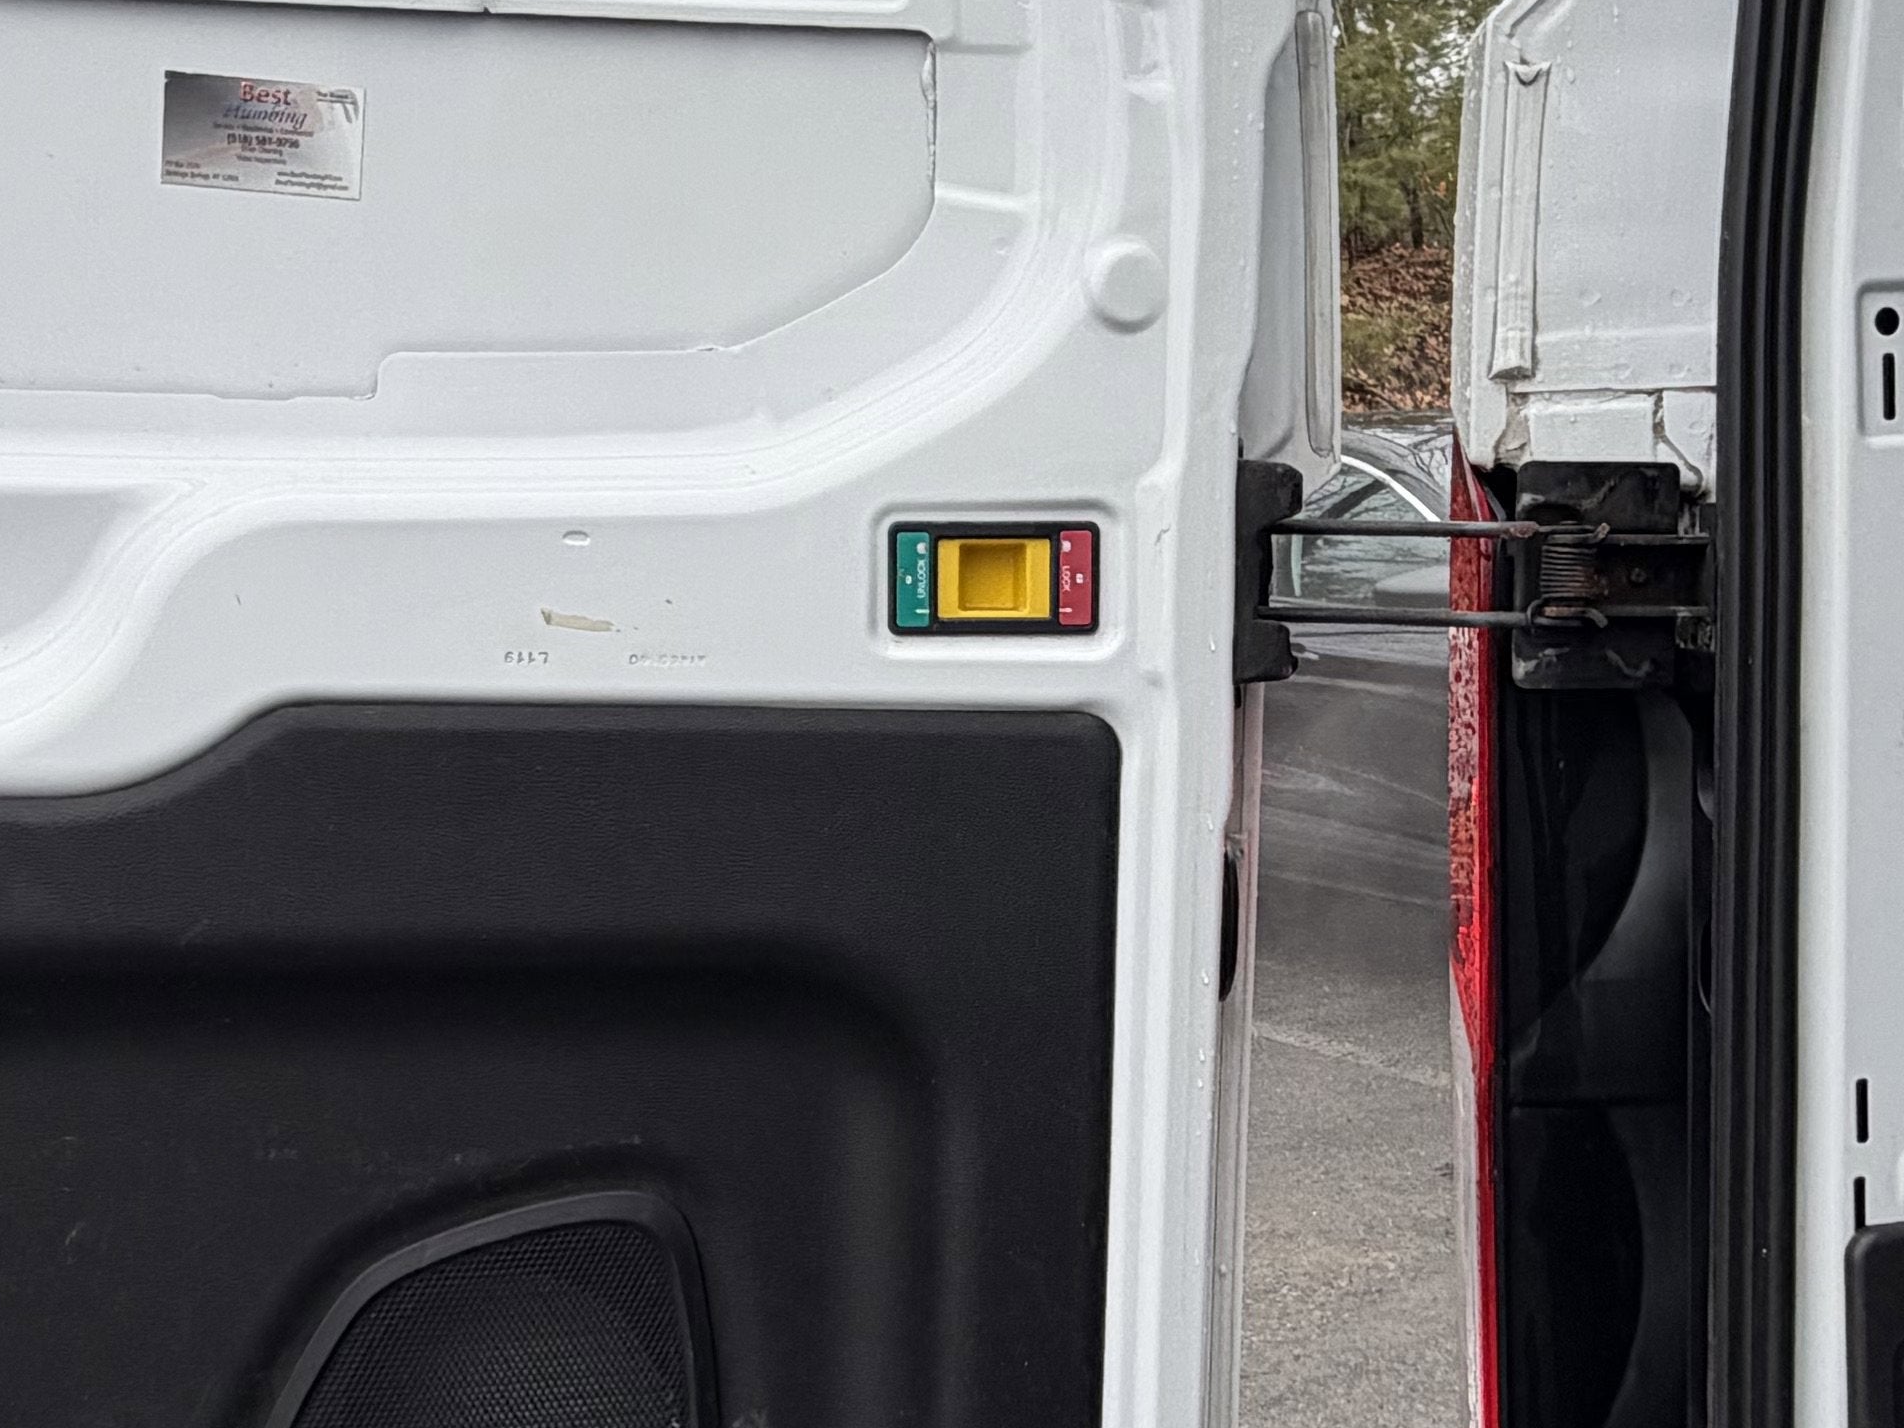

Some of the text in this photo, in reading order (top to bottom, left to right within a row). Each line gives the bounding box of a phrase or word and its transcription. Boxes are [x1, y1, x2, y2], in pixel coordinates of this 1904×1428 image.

[240, 81, 292, 106] Best
[916, 559, 926, 599] UNLOCK
[1062, 565, 1071, 592] LOCK
